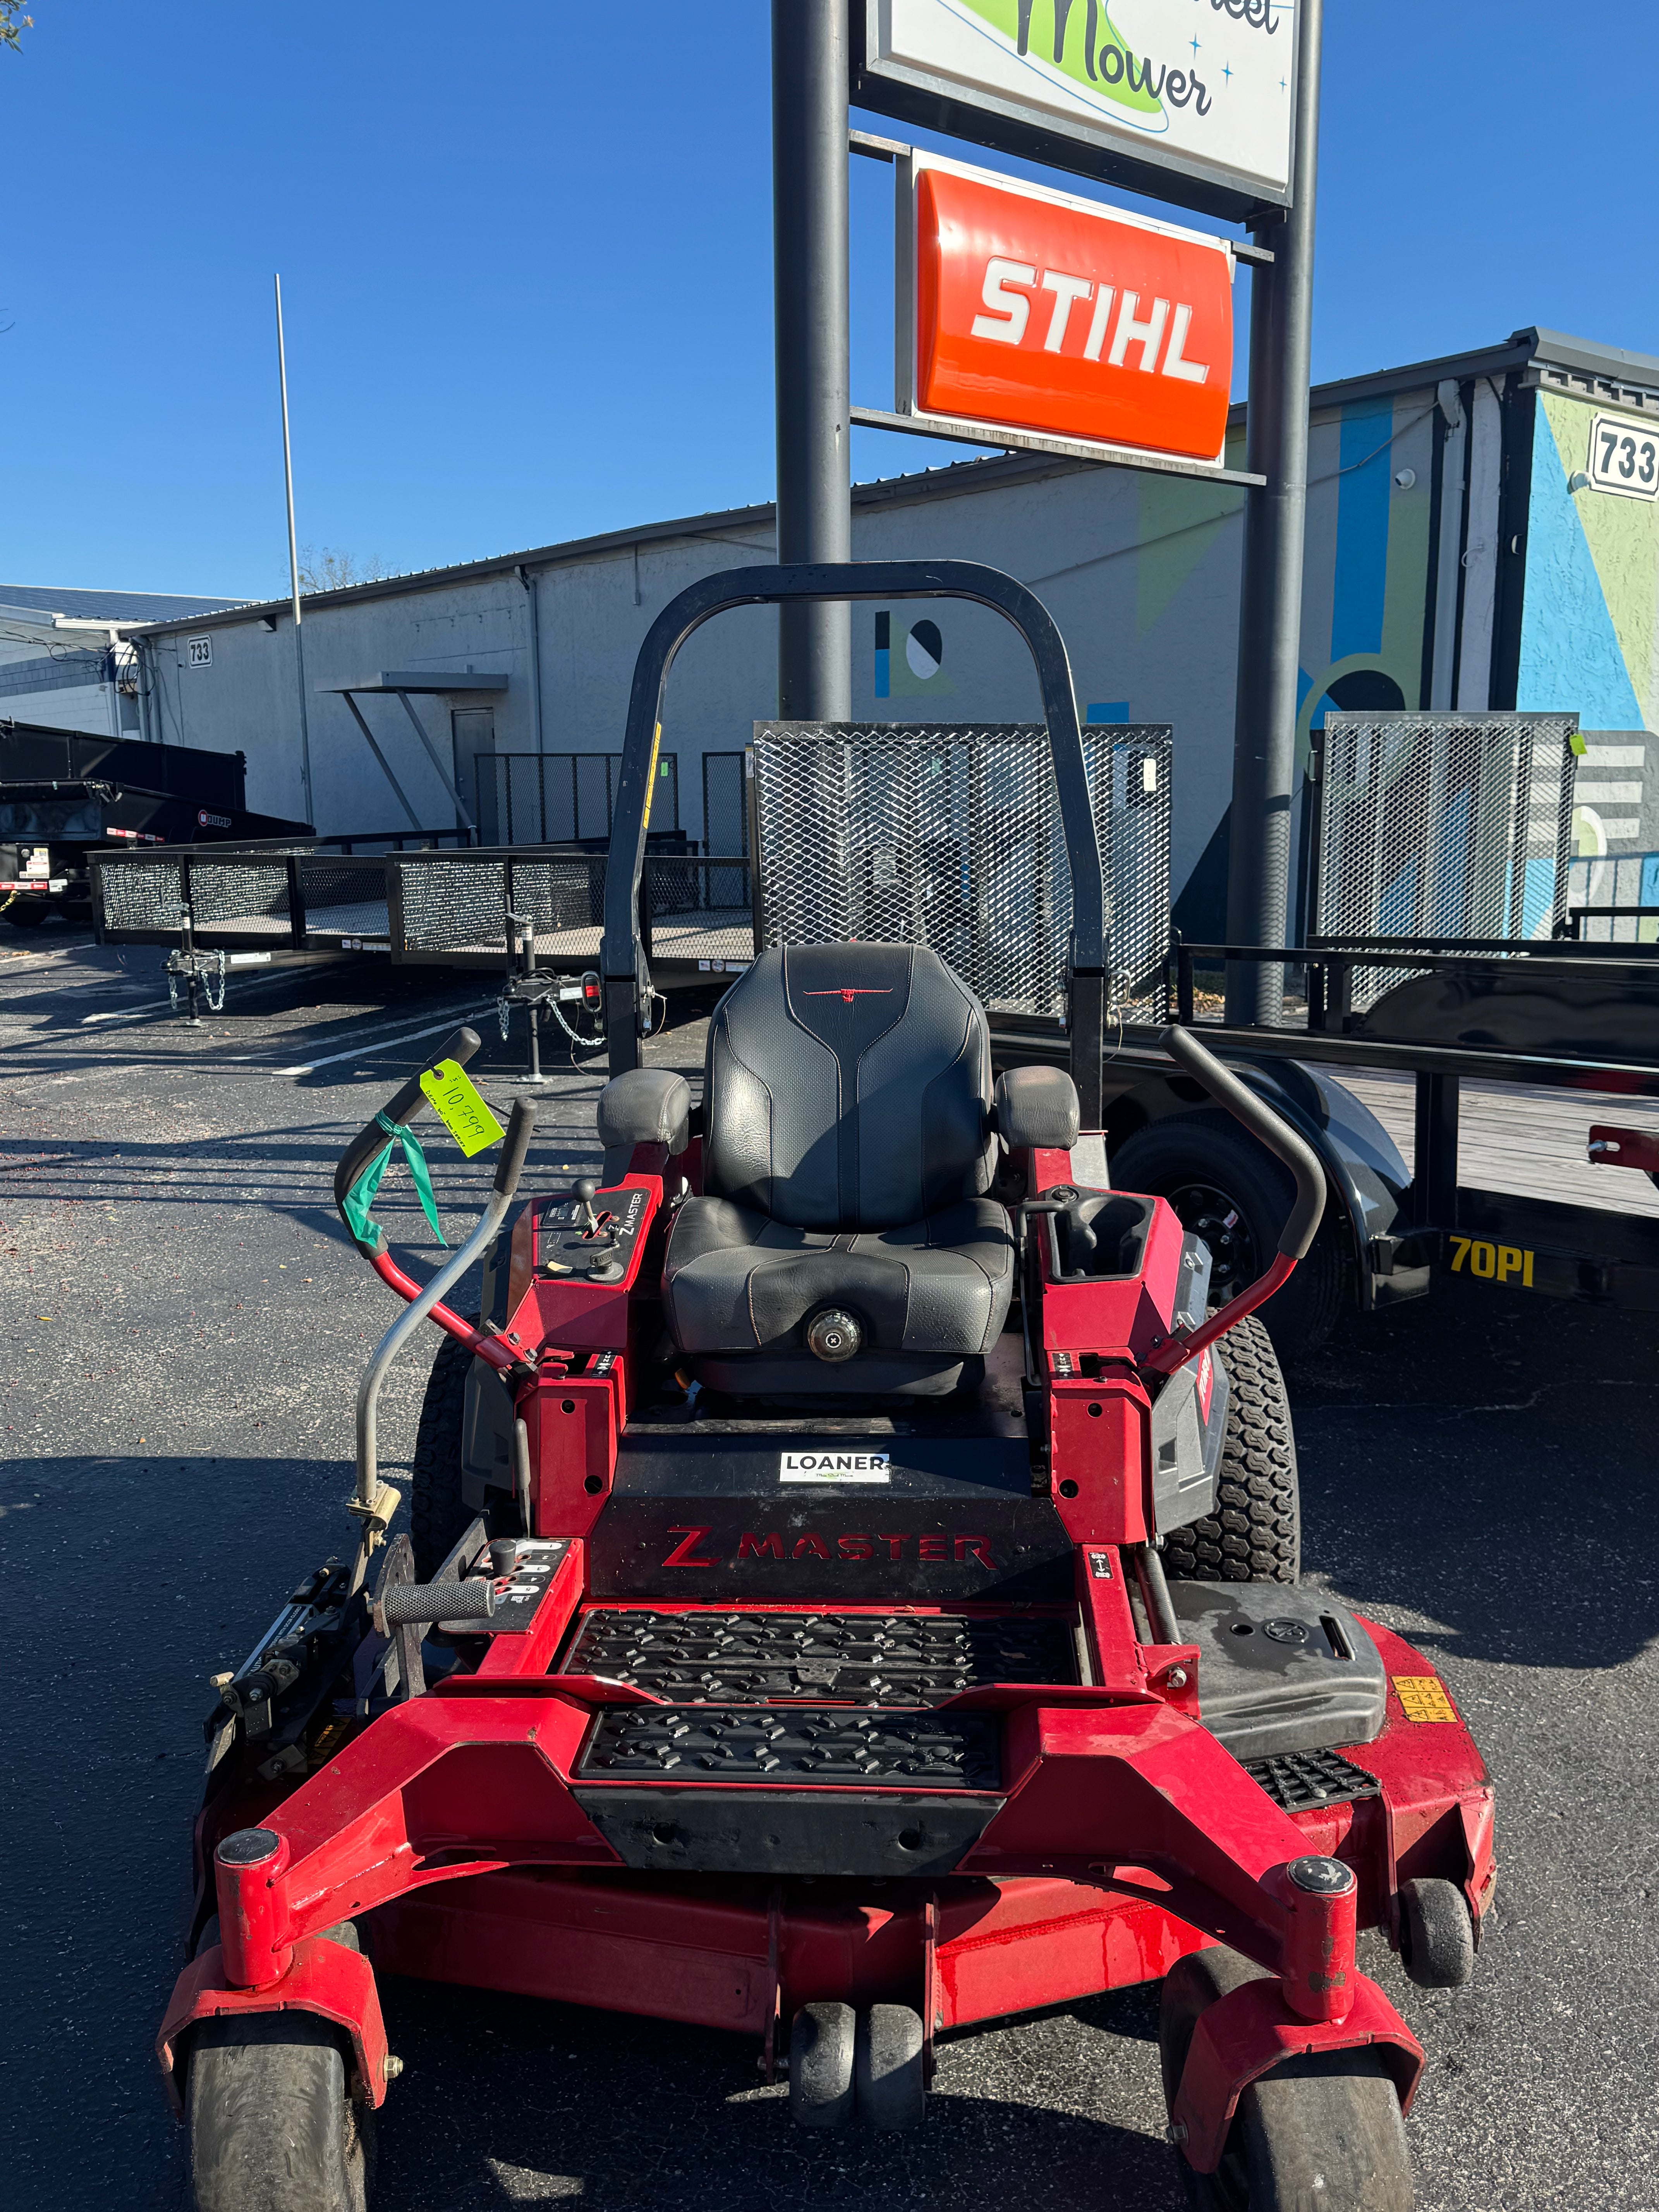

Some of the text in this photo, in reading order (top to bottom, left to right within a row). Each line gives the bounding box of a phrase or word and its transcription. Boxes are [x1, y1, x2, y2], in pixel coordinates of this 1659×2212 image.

[1017, 0, 1211, 116] Mower
[971, 256, 1210, 383] STIHL
[1601, 431, 1656, 483] 733
[191, 642, 209, 661] 733
[619, 1193, 643, 1235] Z MASTER
[787, 1456, 884, 1470] LOANER
[661, 1526, 999, 1570] Z MASTER
